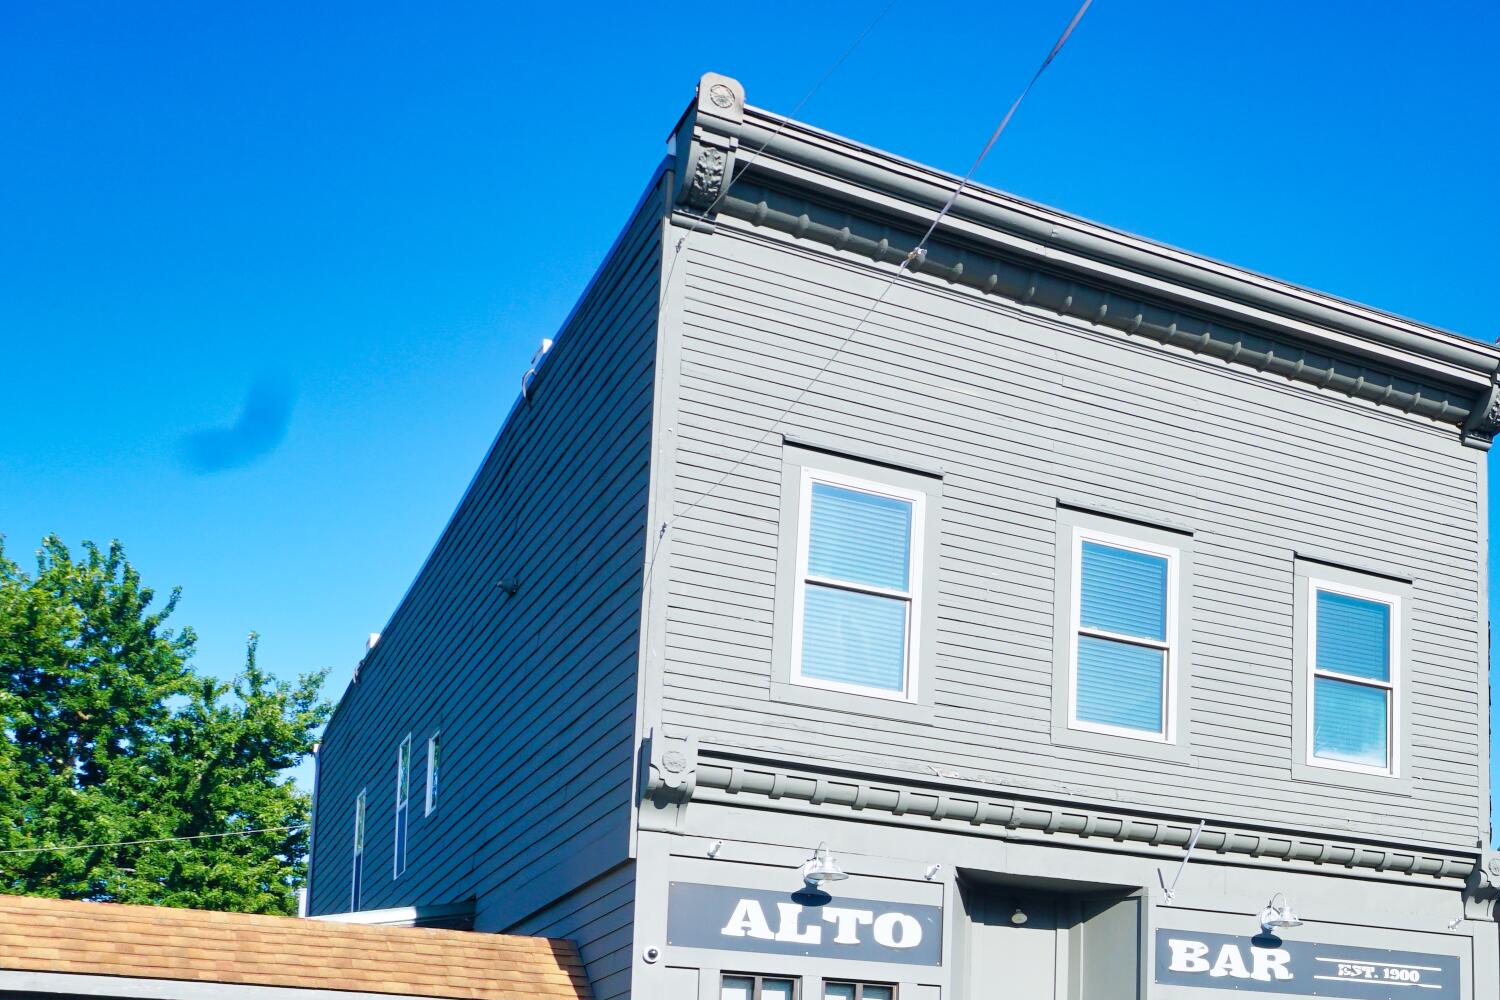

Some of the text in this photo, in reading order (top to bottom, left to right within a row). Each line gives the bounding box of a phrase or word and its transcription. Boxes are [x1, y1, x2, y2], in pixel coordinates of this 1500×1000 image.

[721, 898, 923, 949] ALTO
[1168, 938, 1420, 983] BAR EST. 1900
